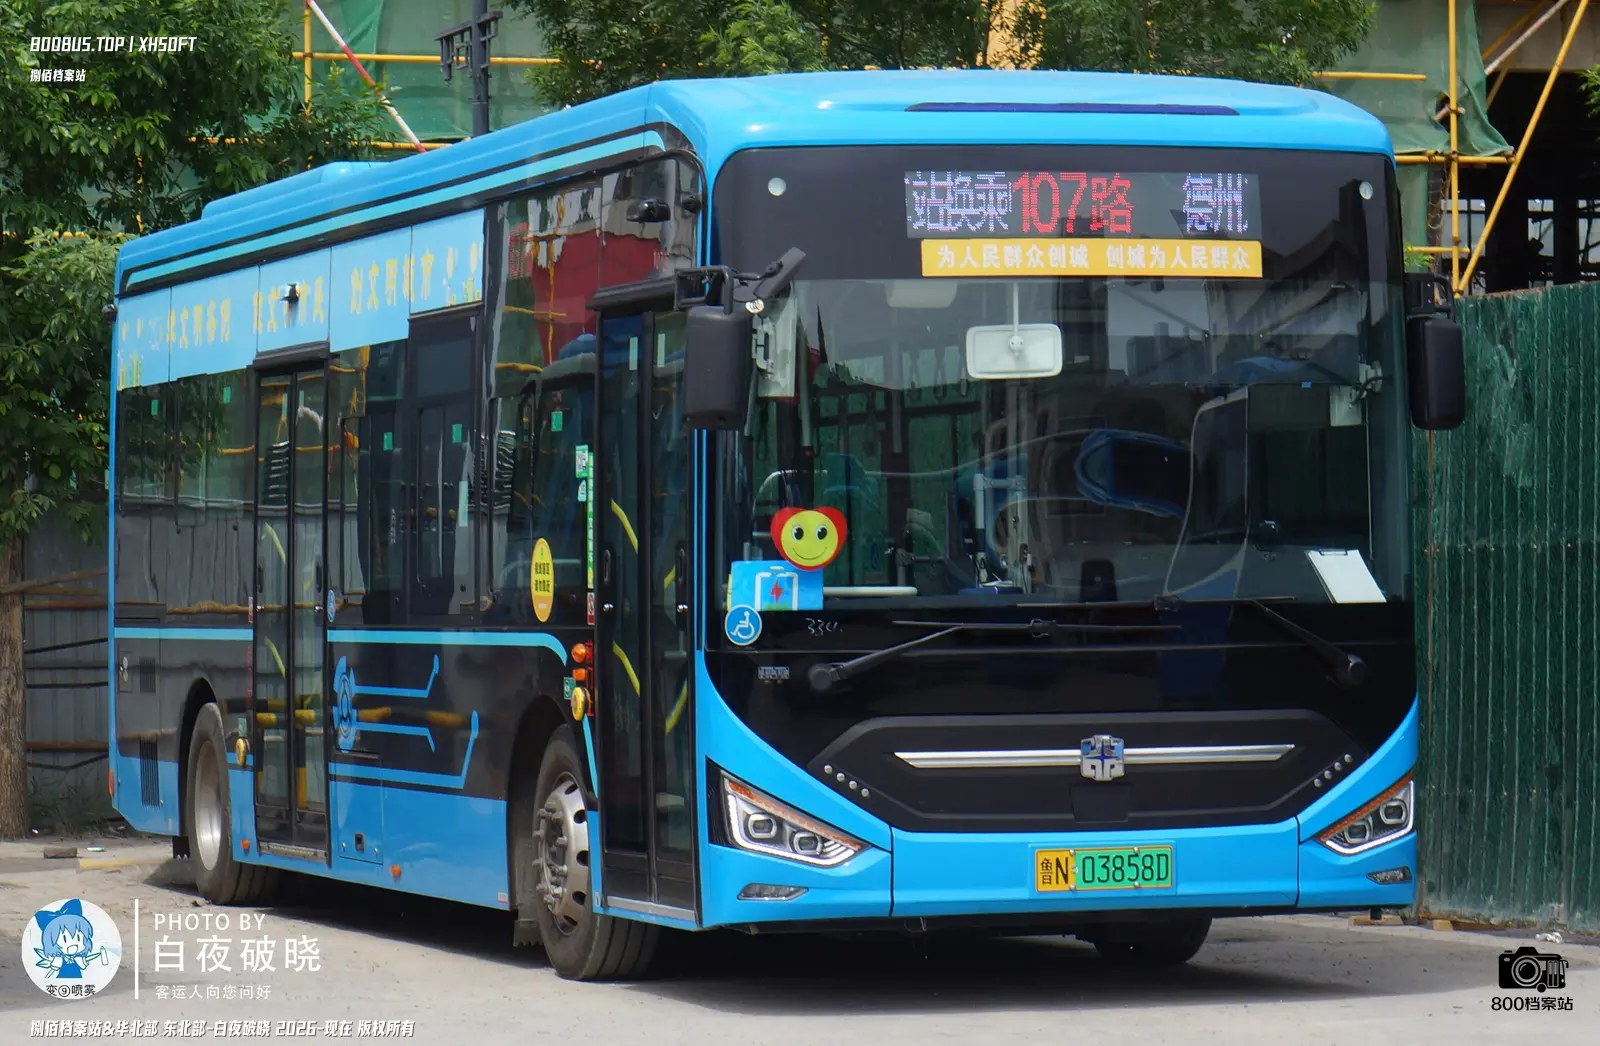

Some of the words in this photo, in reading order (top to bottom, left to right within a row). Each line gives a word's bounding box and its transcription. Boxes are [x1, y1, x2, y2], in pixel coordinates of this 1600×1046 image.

[937, 244, 1090, 269] 为人民群众创城
[1105, 244, 1250, 270] 创城为人民群众
[1040, 857, 1069, 885] 鲁N
[1082, 853, 1169, 883] 03858D
